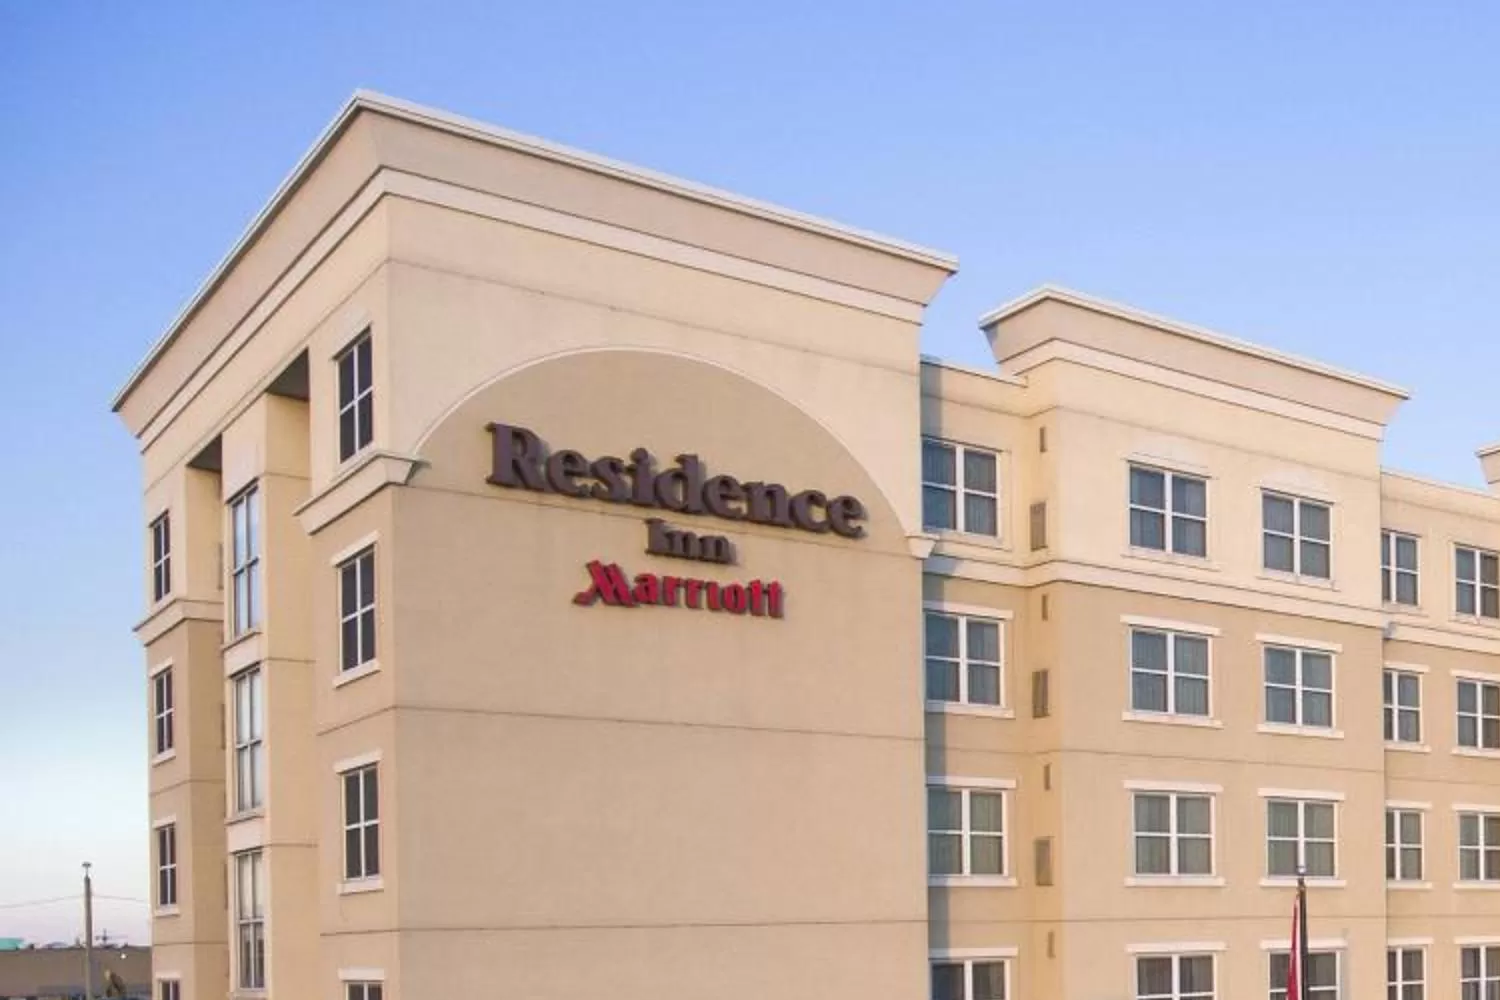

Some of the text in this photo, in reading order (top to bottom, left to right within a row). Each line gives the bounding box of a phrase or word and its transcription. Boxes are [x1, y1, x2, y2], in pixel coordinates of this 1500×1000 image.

[485, 421, 868, 539] Residence
[644, 517, 738, 565] Inn
[572, 559, 784, 619] Marriott
